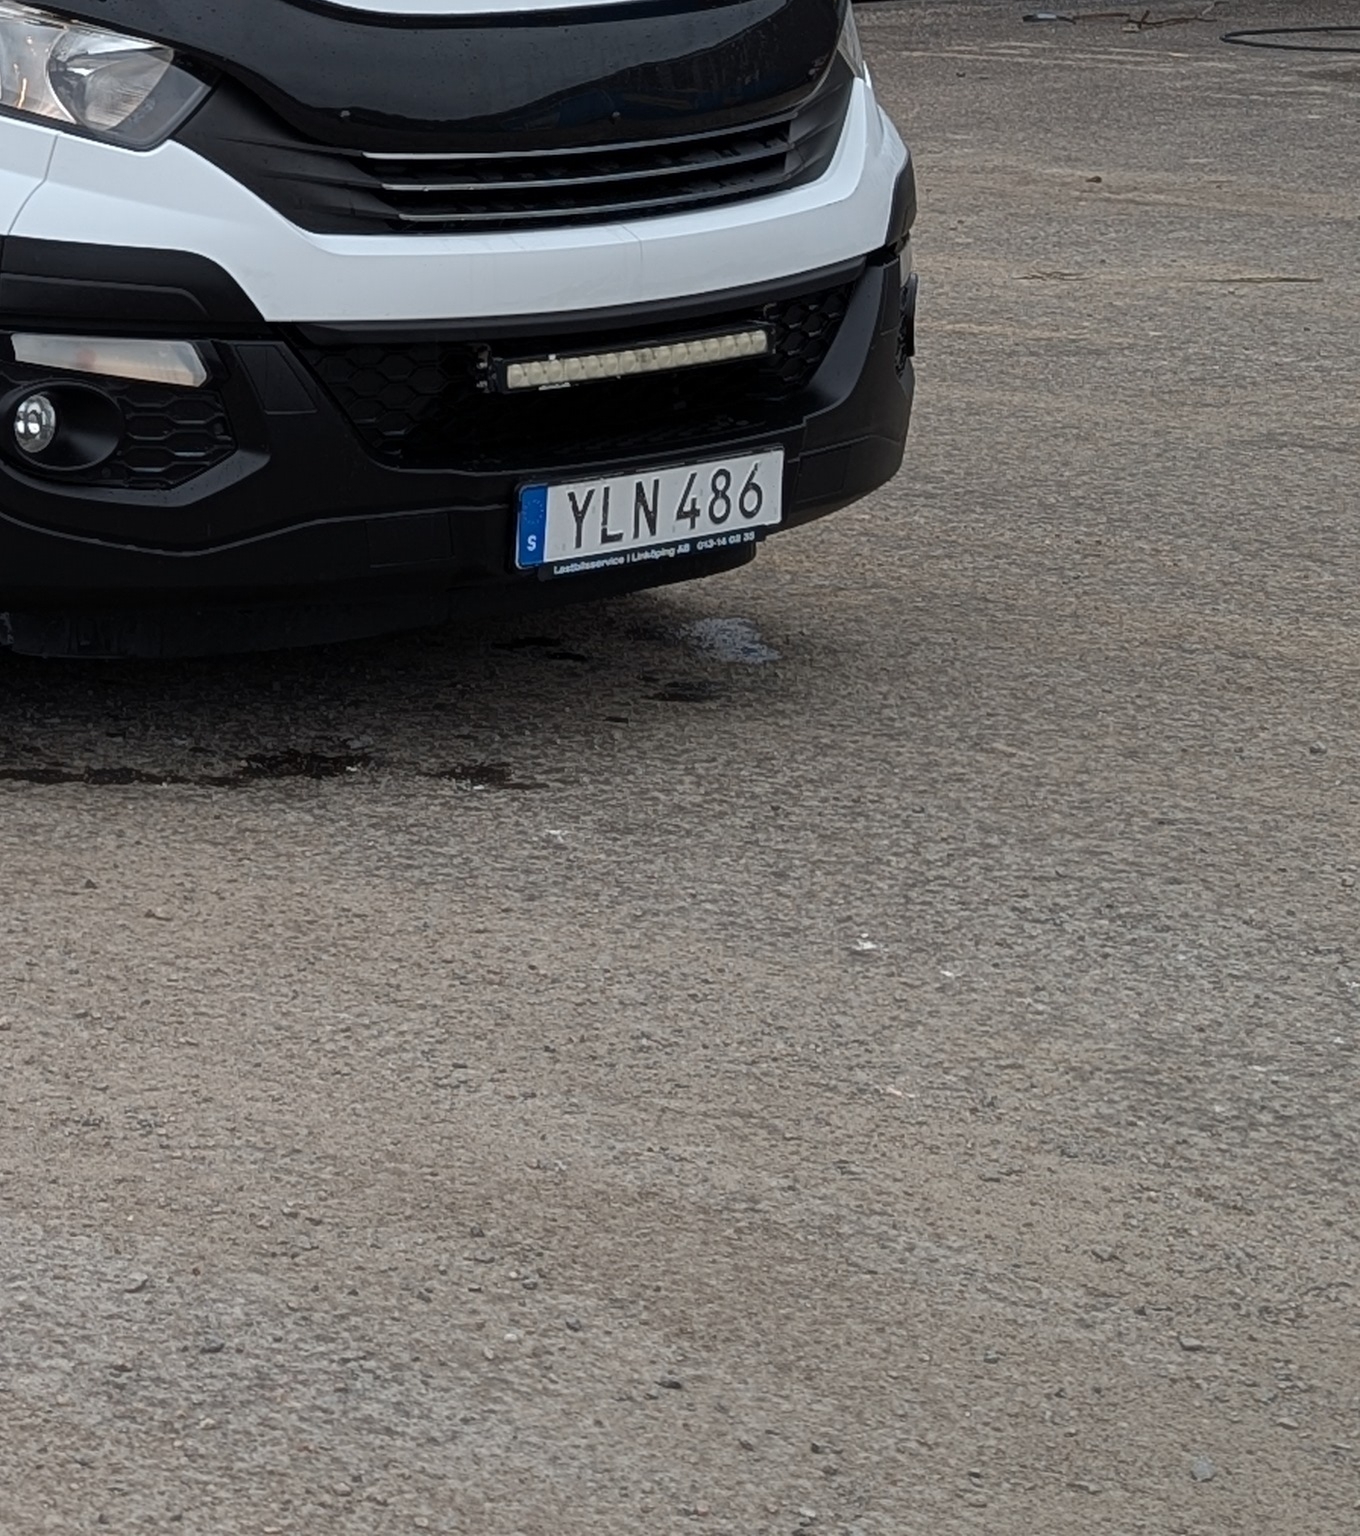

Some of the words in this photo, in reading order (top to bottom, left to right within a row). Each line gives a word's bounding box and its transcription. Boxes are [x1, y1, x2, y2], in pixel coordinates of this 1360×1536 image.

[567, 478, 660, 549] YLN
[676, 462, 763, 530] 486
[526, 534, 538, 552] S
